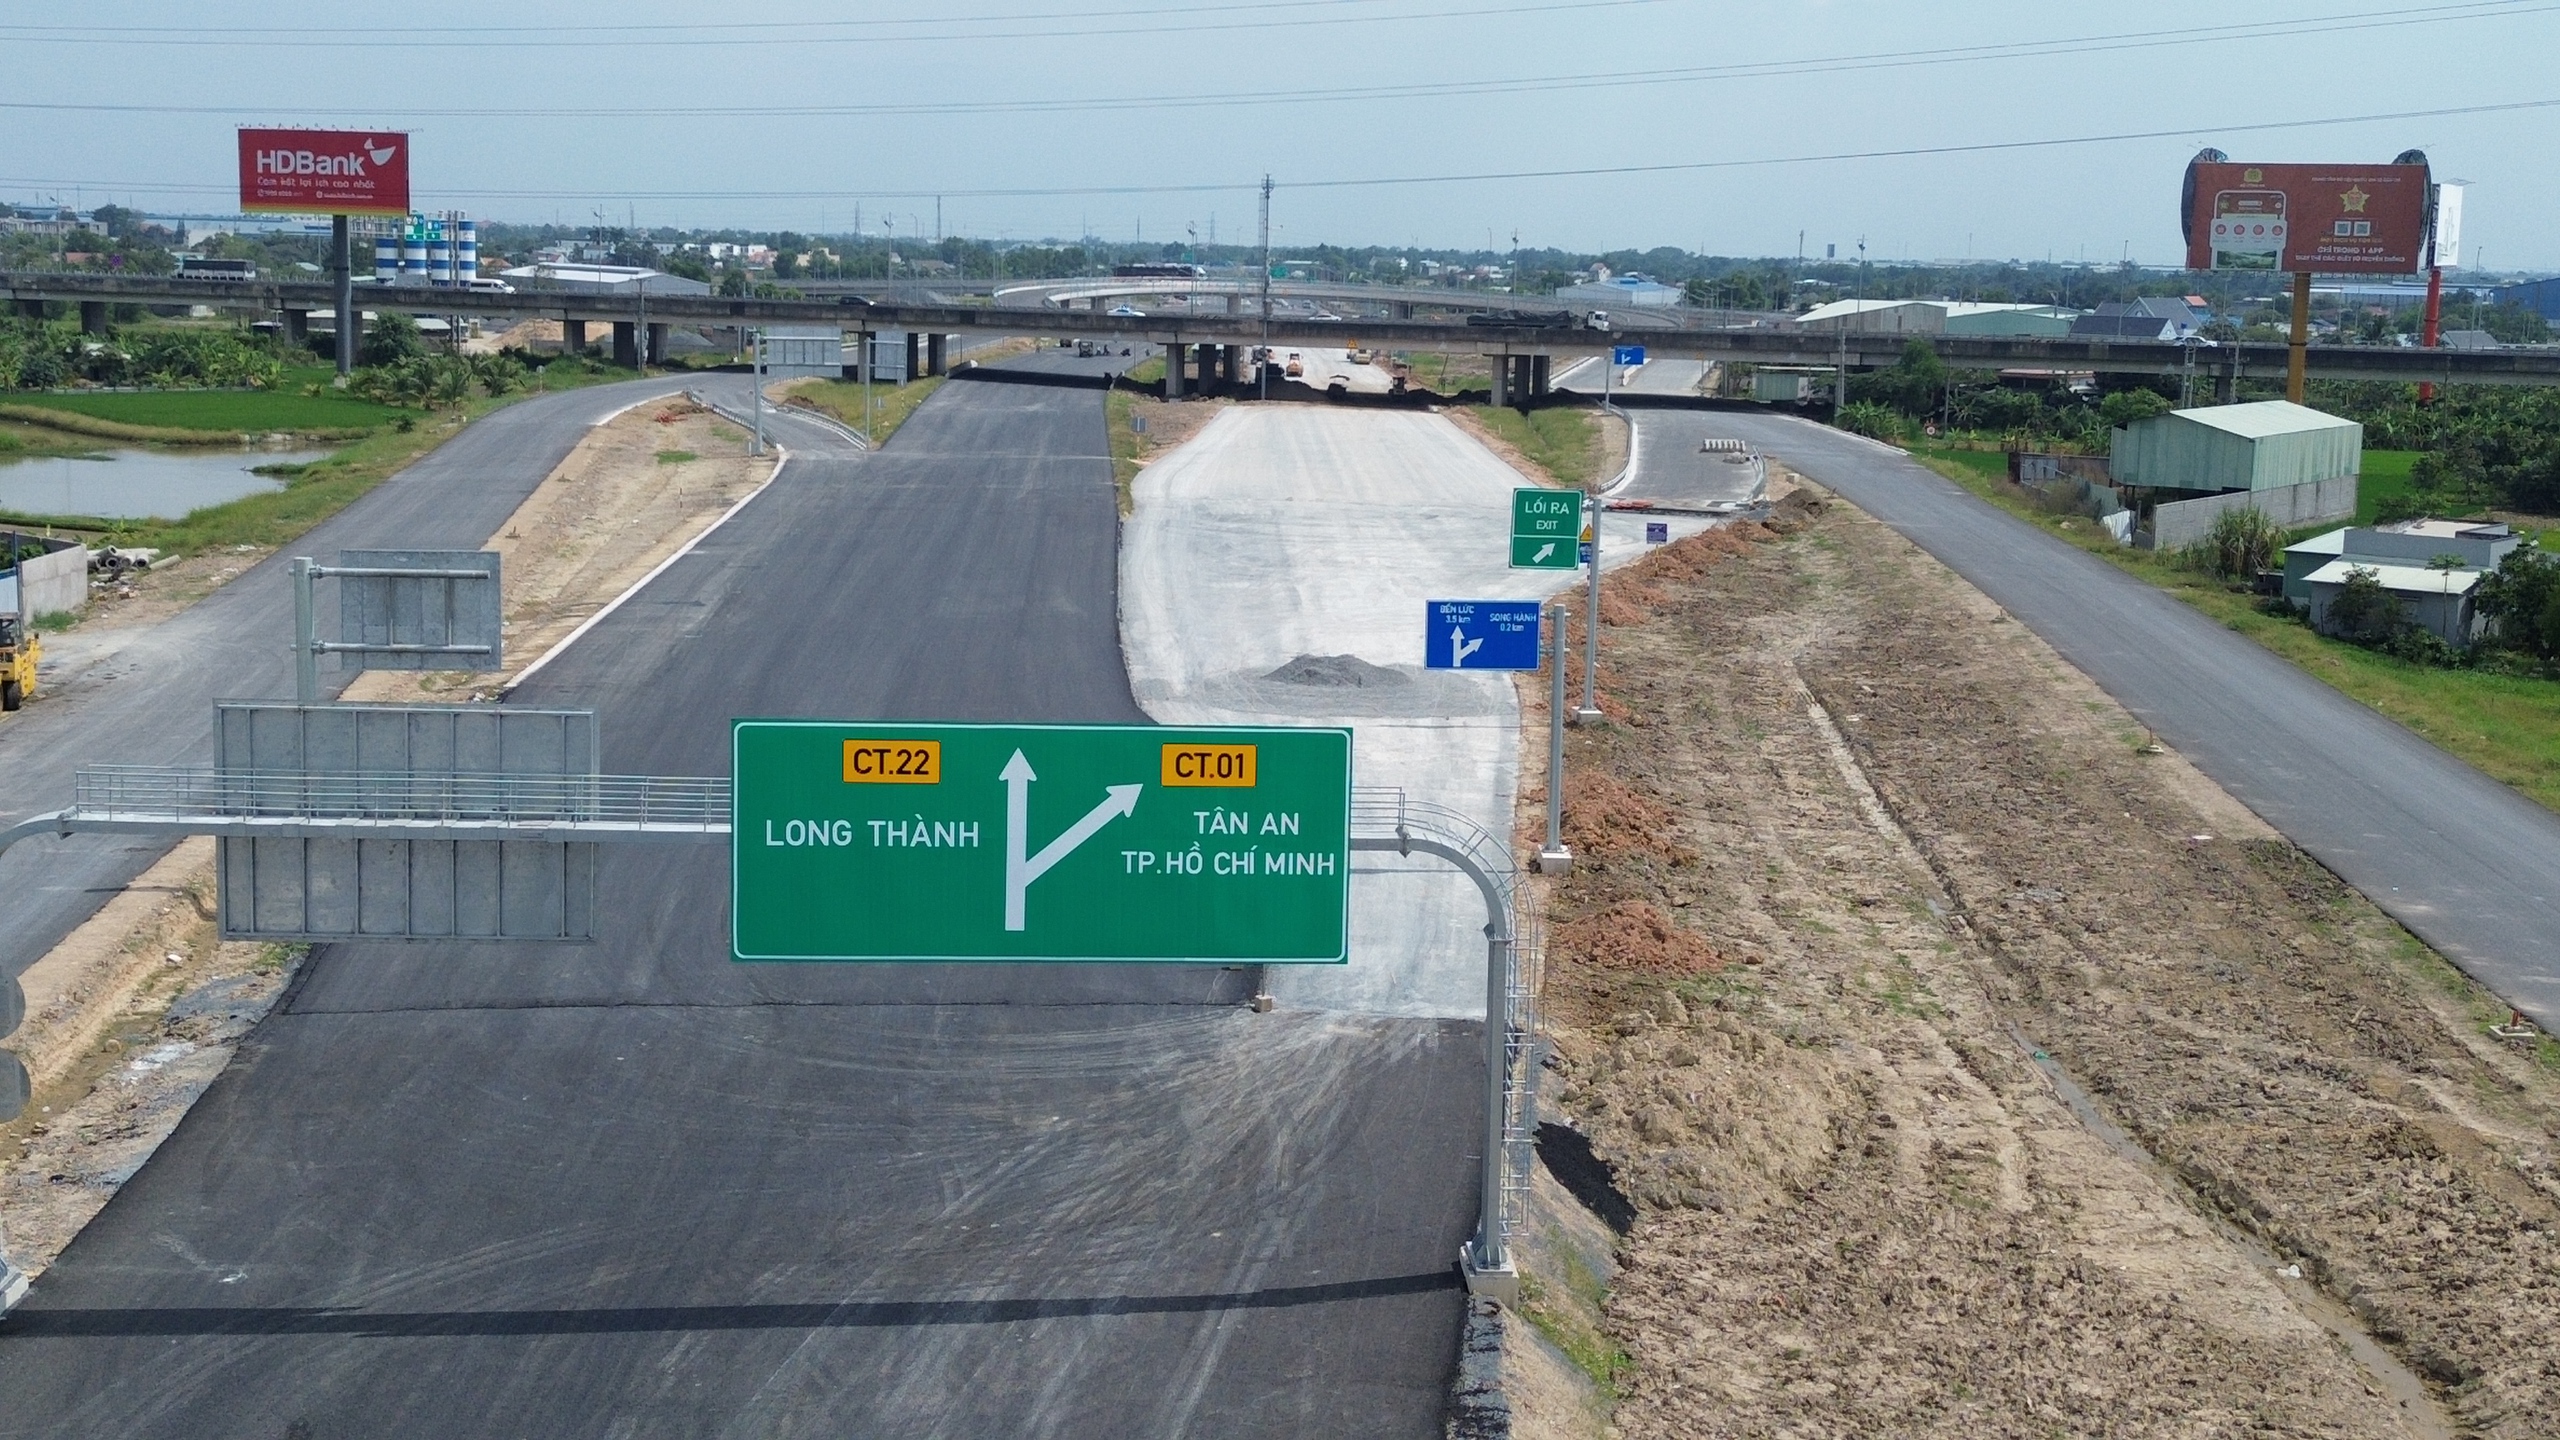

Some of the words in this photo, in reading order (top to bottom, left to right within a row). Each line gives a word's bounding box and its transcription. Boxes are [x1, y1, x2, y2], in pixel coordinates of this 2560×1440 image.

[257, 150, 366, 176] HDBank
[1525, 496, 1547, 514] LỐI
[1551, 502, 1570, 515] RA
[1536, 520, 1559, 530] EXIT
[1440, 602, 1457, 614] BẾN
[1457, 604, 1475, 614] LỨC
[1445, 615, 1457, 623] 3.5
[1458, 615, 1471, 623] km
[1489, 613, 1512, 622] SONG
[1513, 611, 1537, 622] HÀNH
[1500, 623, 1511, 632] 0.2
[1512, 623, 1524, 632] km
[853, 748, 930, 776] CT.22
[1174, 752, 1245, 779] CT.01
[765, 820, 852, 847] LONG
[868, 814, 980, 848] THÀNH
[1194, 807, 1248, 835] TÂN
[1260, 812, 1300, 836] AN
[1121, 842, 1204, 875] TP.HỒ
[1213, 846, 1257, 875] CHÍ
[1265, 852, 1335, 876] MINH
